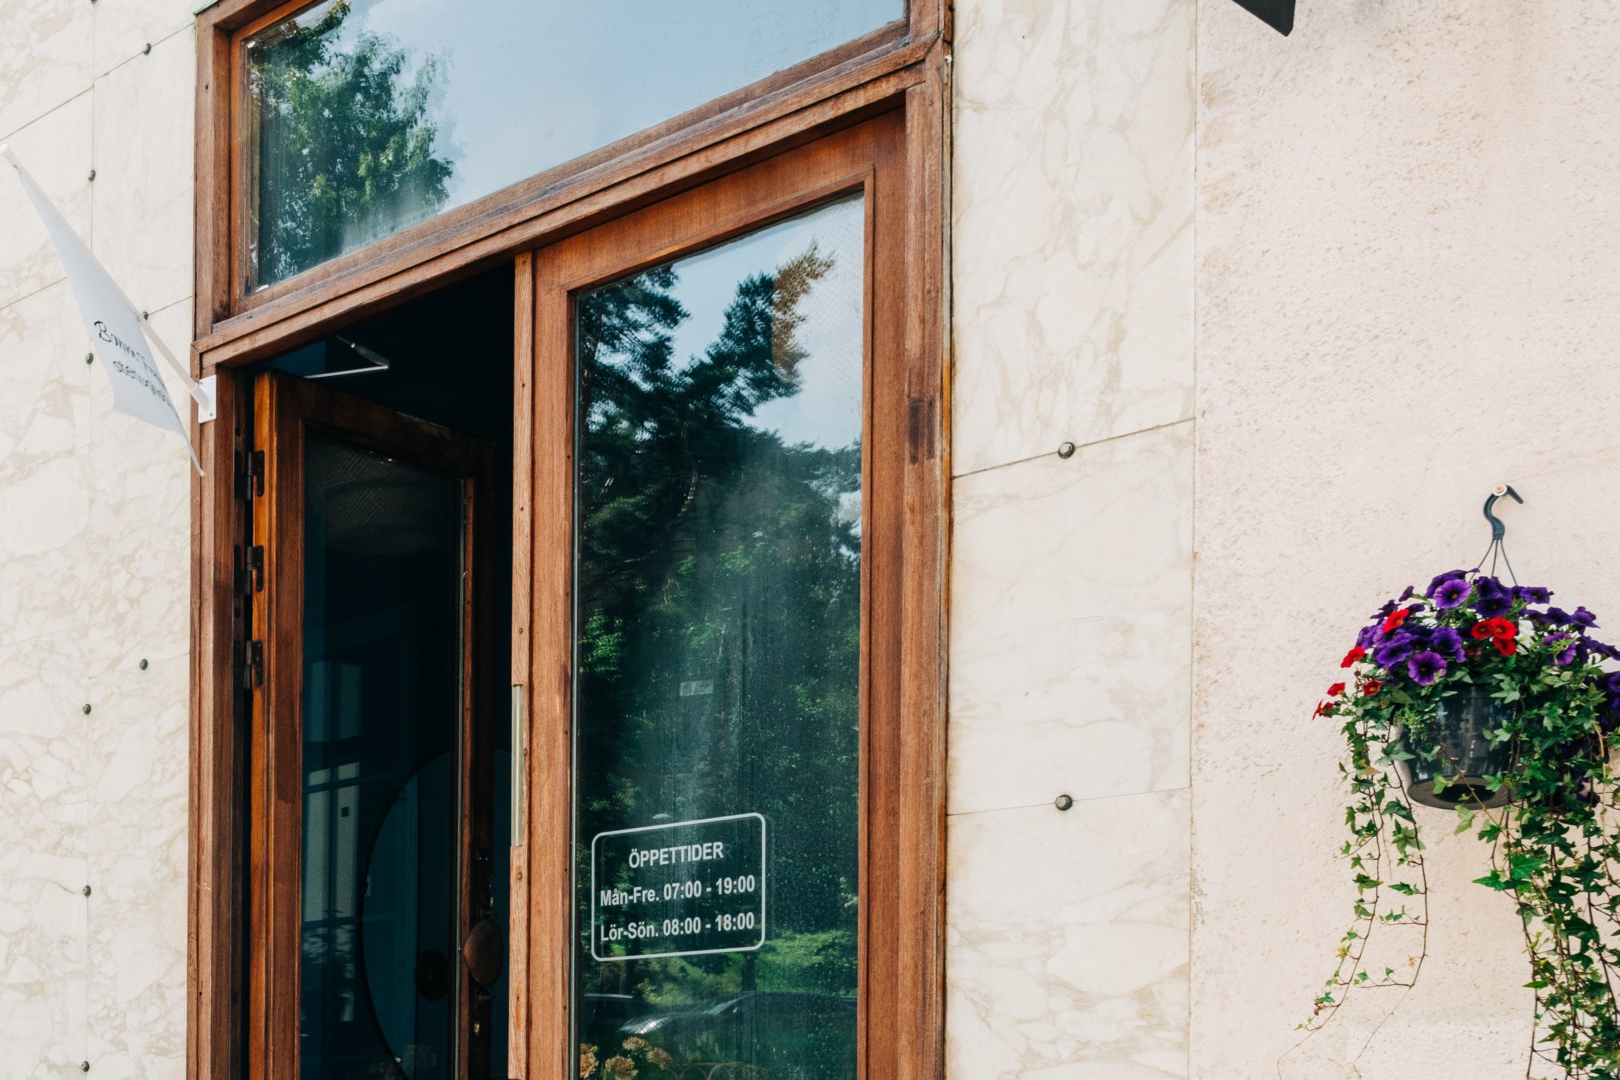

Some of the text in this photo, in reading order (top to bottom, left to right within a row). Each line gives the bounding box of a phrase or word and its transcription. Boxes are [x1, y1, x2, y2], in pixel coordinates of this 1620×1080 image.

[628, 841, 724, 869] ÖPPETTIDER
[600, 886, 660, 907] Mån-Fre.
[663, 880, 702, 901] 07:00
[715, 874, 756, 896] 19:00
[600, 923, 659, 941] Lör-Sön.
[662, 916, 702, 937] 08:00
[715, 911, 755, 933] 18:00
